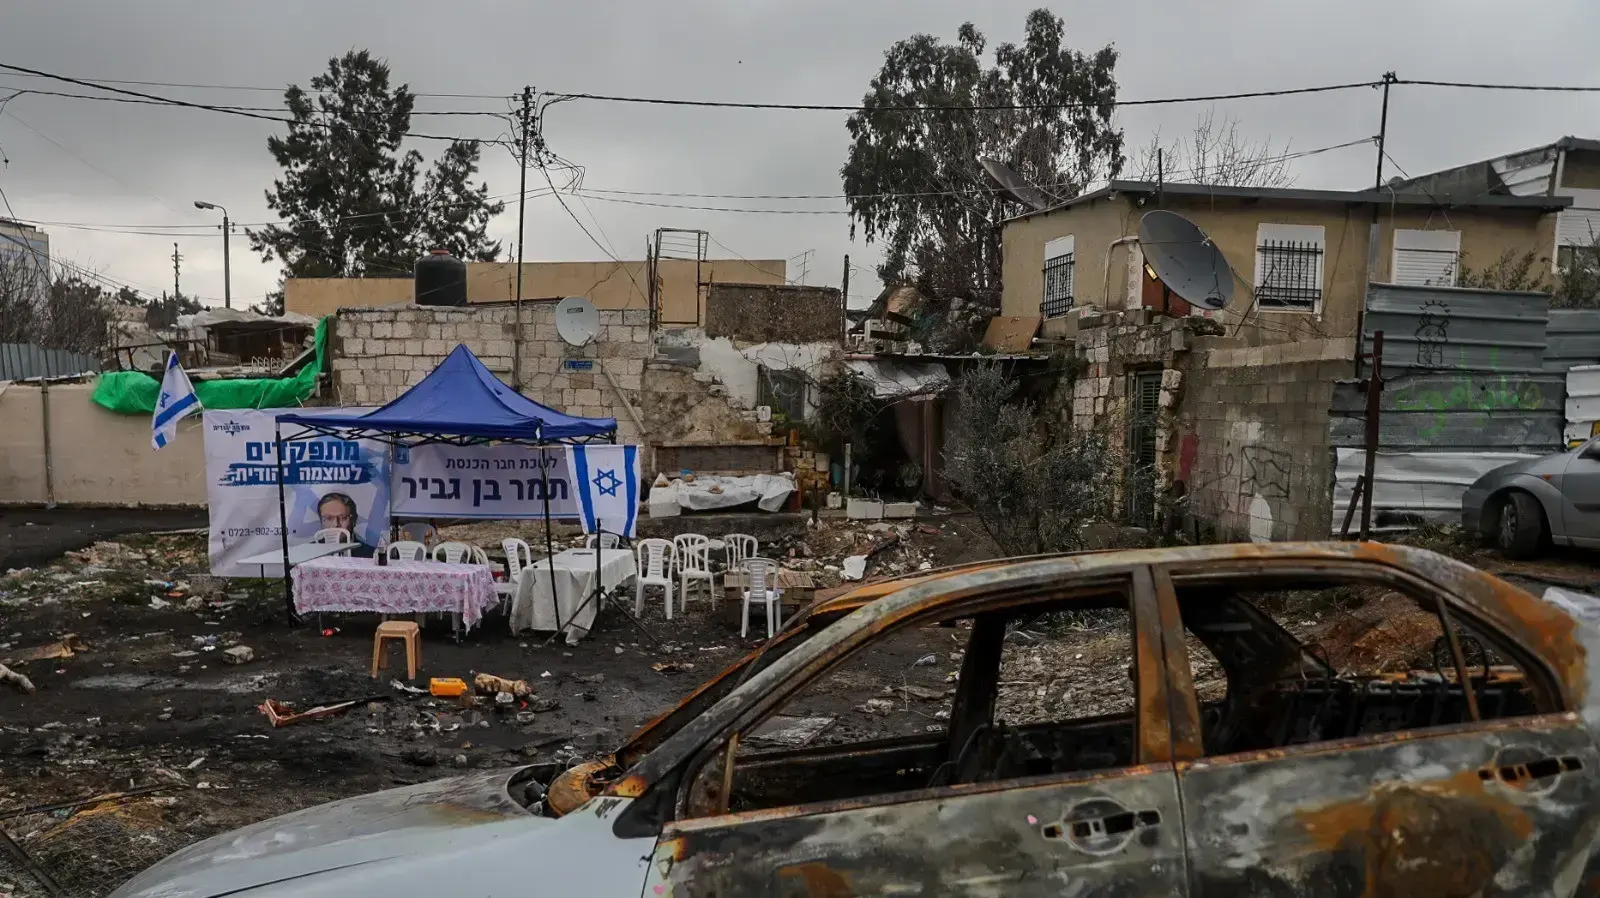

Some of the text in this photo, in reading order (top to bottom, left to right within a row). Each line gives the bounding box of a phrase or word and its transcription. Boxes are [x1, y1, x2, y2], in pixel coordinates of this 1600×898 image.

[246, 441, 360, 462] מתפקדים
[445, 456, 558, 470] לשכת חבר הכנסת
[235, 464, 363, 482] לעוצמה יהודית
[401, 476, 572, 507] תמר בן גביר
